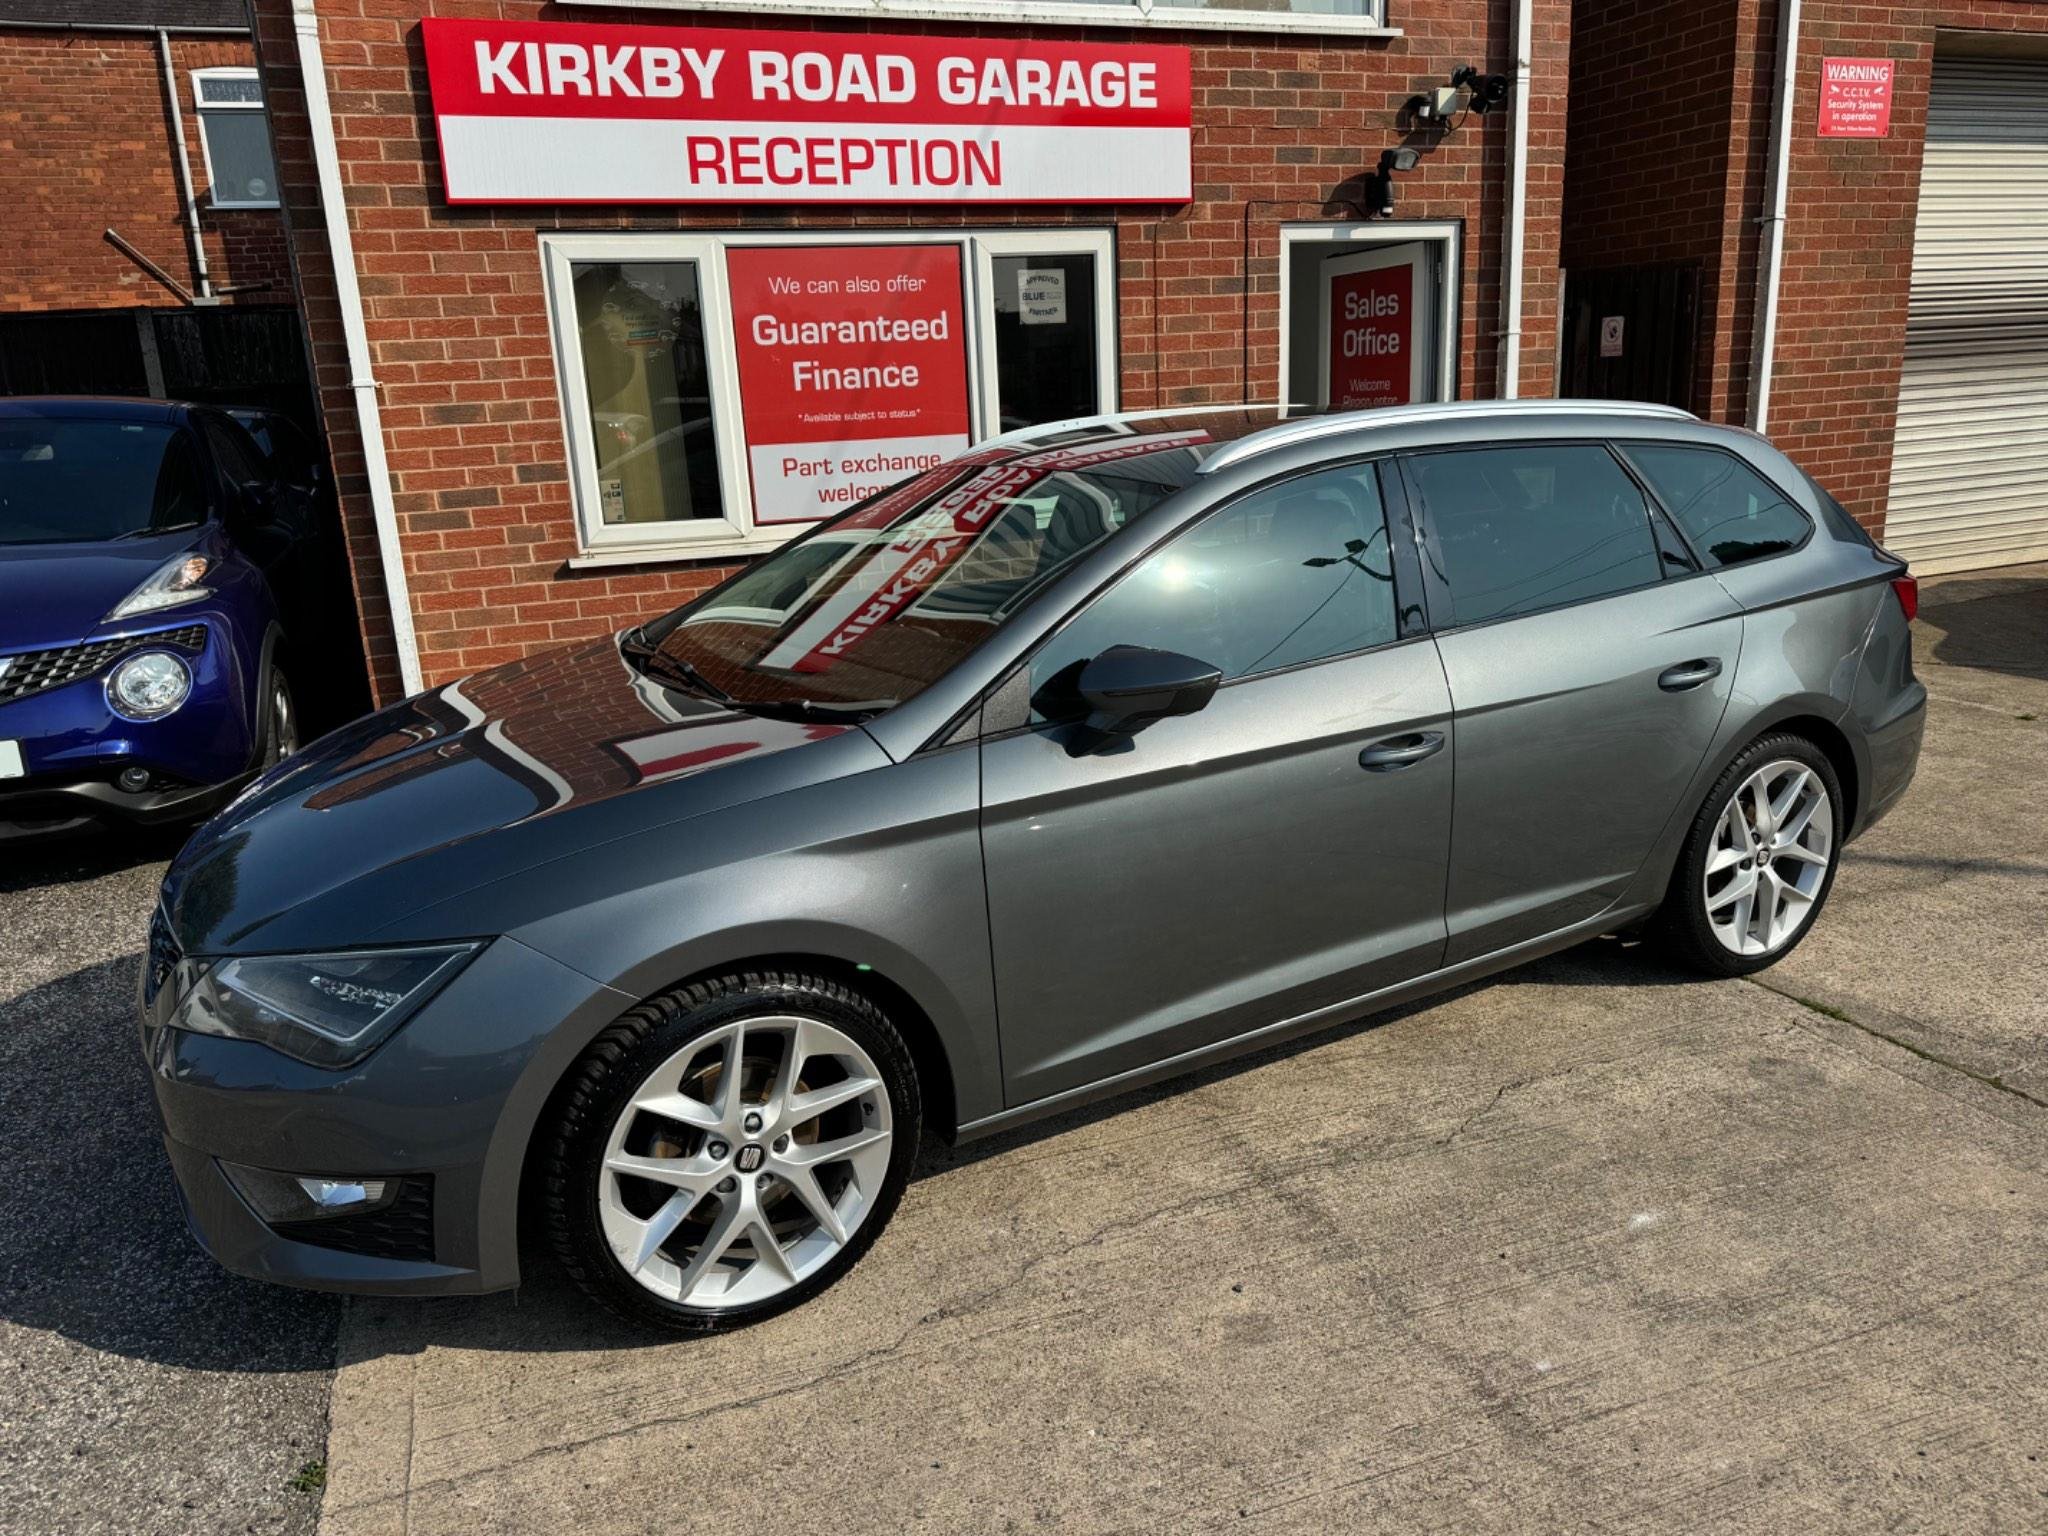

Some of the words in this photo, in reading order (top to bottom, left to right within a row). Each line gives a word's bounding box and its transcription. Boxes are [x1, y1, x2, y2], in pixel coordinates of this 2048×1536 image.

[474, 40, 726, 100] KIRKBY
[750, 50, 917, 103] ROAD
[938, 56, 1158, 109] GARAGE
[1827, 64, 1889, 81] WARNING
[1828, 99, 1857, 111] Security
[1858, 99, 1884, 111] System
[1841, 112, 1877, 122] operation
[687, 135, 1002, 187] RECEPTION
[768, 276, 800, 295] We
[807, 280, 839, 294] can
[845, 275, 881, 293] also
[886, 274, 926, 292] offer
[1344, 288, 1399, 320] Sales
[752, 310, 949, 346] Guaranteed
[1343, 327, 1400, 358] Office
[792, 361, 919, 391] Finance
[1349, 377, 1392, 392] Welcome
[844, 410, 876, 422] subject
[877, 411, 887, 419] to
[783, 458, 833, 477] Part
[841, 453, 942, 474] exchange
[818, 482, 890, 503] welco
